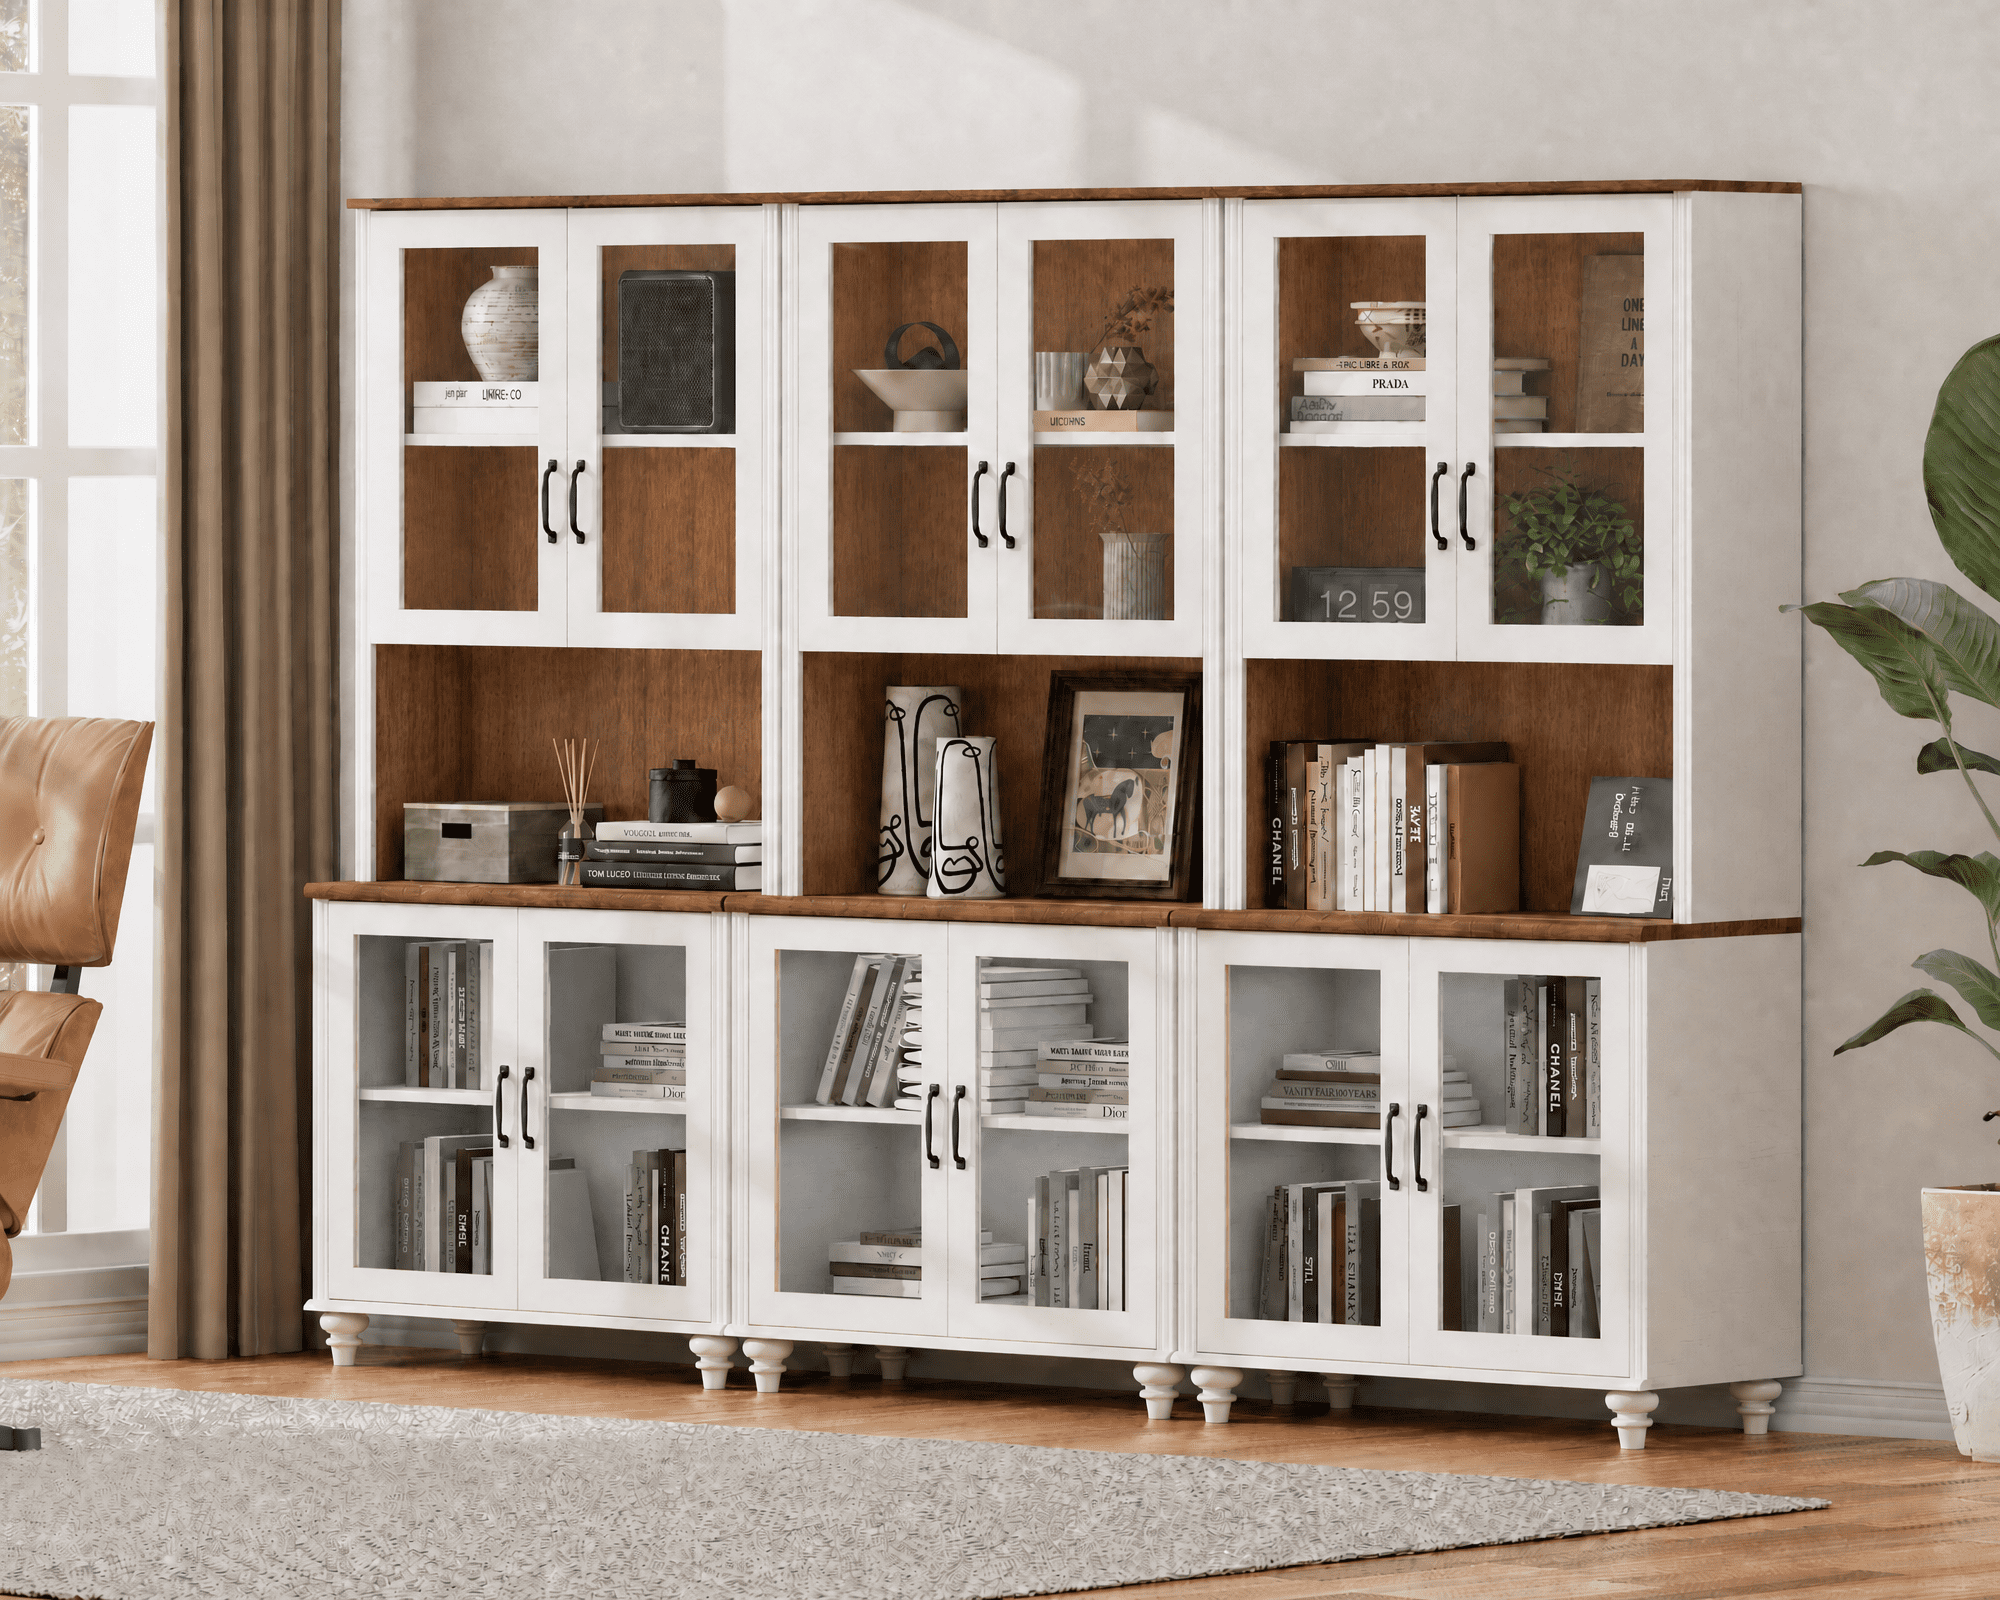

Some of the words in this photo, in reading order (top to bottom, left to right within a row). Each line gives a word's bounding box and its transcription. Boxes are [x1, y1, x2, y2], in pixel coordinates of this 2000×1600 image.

[1623, 298, 1645, 312] ONE
[1621, 317, 1645, 331] LINE
[1630, 337, 1638, 350] A
[1372, 378, 1410, 389] PRADA
[1320, 589, 1357, 619] 12
[1372, 590, 1413, 619] 59
[1272, 817, 1283, 886] CHANEL
[587, 869, 605, 878] TOM
[1550, 1043, 1561, 1113] CHANEL
[662, 1086, 685, 1099] Dior
[1283, 1086, 1315, 1097] VANITY
[1315, 1087, 1336, 1098] FAIR
[1348, 1089, 1378, 1099] YEARS
[1102, 1106, 1127, 1118] Dior
